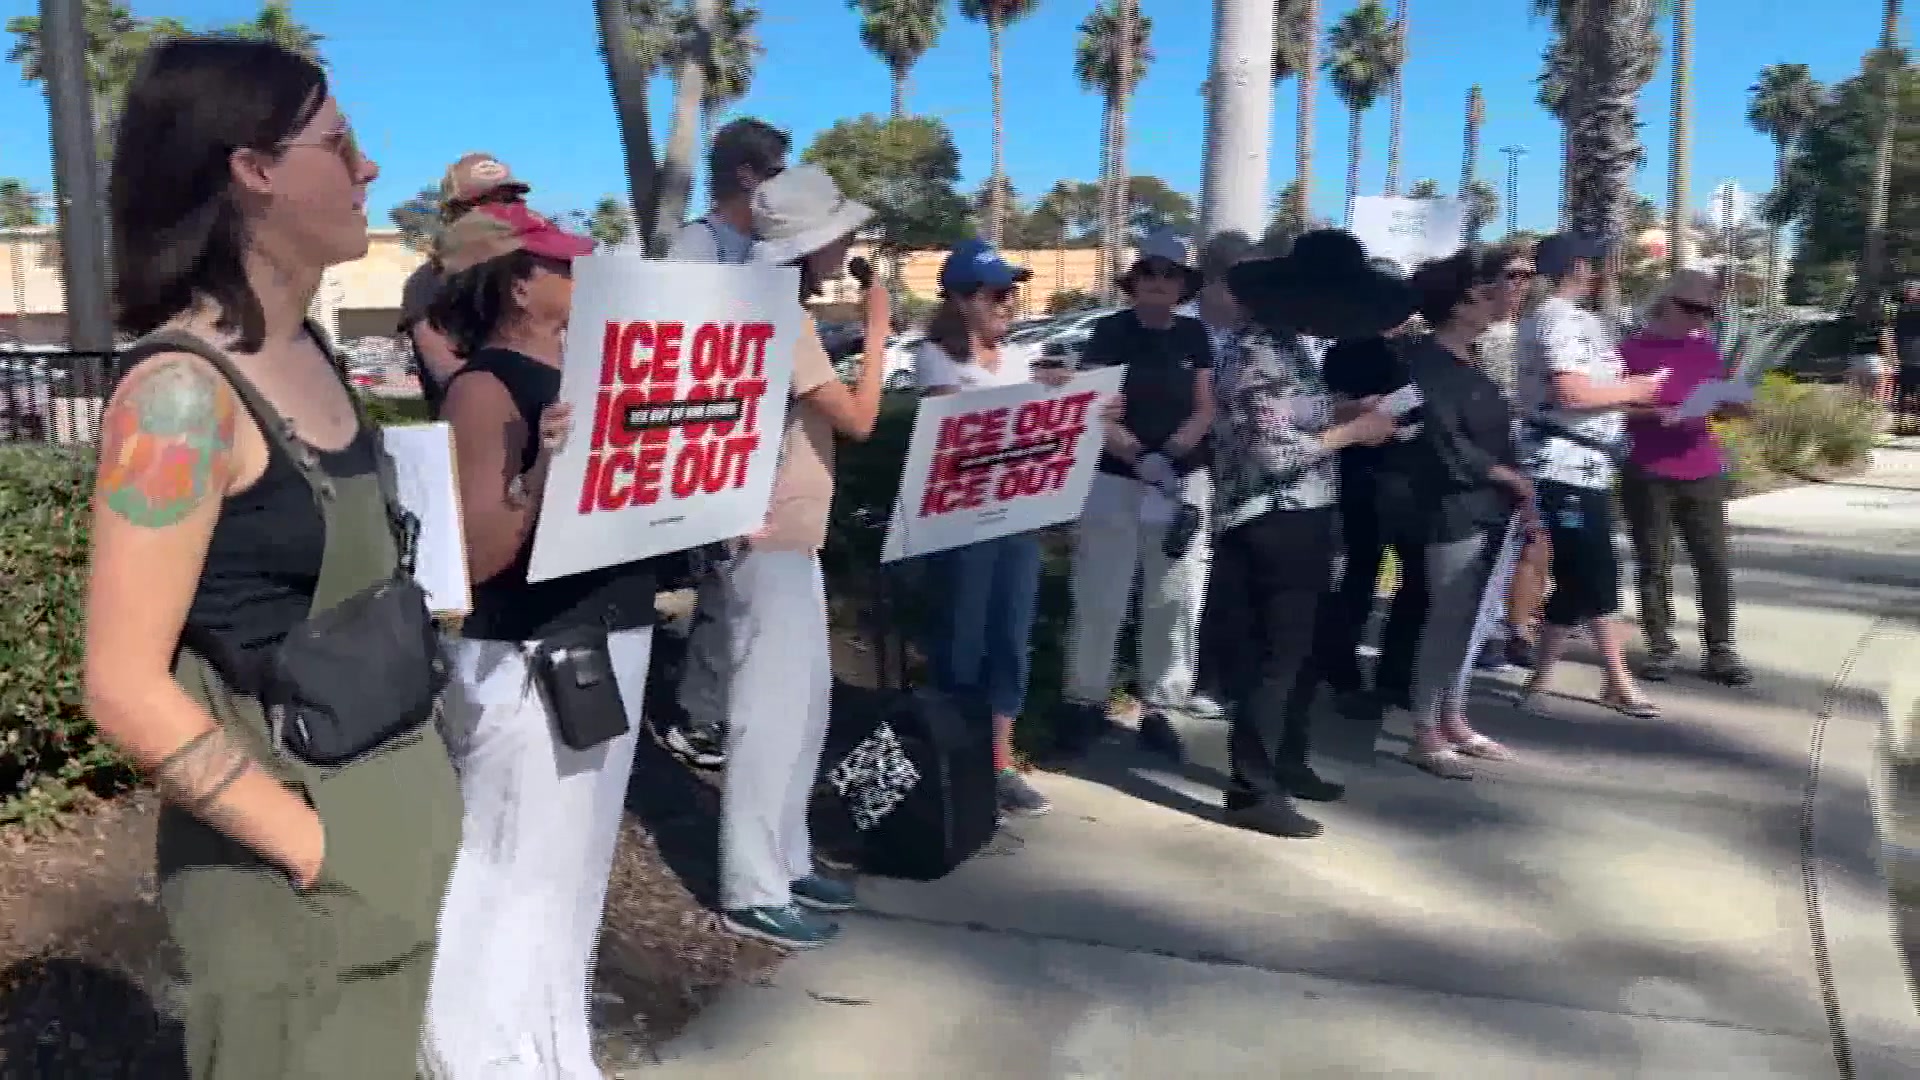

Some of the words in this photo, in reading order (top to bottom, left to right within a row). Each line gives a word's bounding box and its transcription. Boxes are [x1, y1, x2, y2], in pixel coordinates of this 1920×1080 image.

[600, 320, 685, 384] ICE
[690, 321, 775, 380] OUT
[938, 407, 1011, 450] ICE
[1015, 390, 1100, 437] OUT
[577, 446, 668, 514] ICE
[670, 437, 760, 499] OUT
[919, 477, 993, 518] ICE
[996, 459, 1077, 502] OUT
